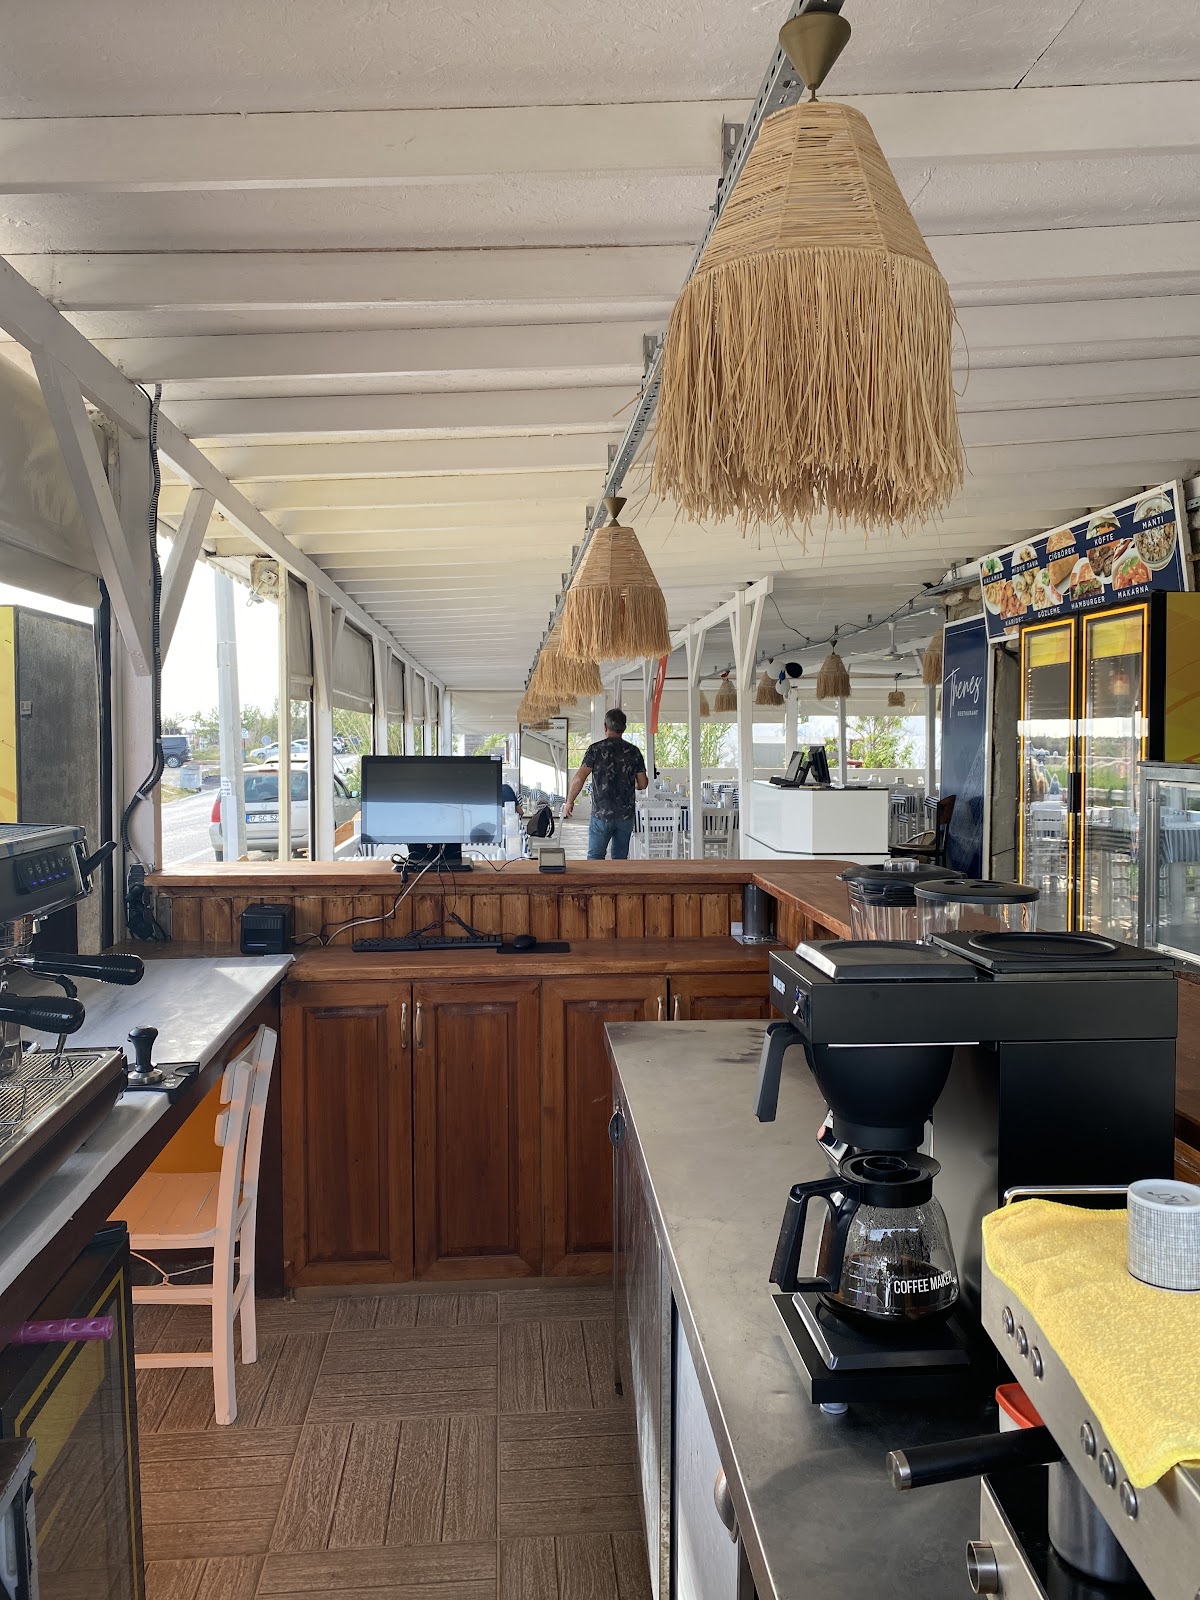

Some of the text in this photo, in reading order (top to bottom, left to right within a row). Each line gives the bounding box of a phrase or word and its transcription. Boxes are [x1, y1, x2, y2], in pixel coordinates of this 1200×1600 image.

[1142, 516, 1164, 529] MANTI
[1094, 533, 1114, 546] KÖFTE
[1048, 547, 1076, 562] ÇİĞBÖREK
[1117, 585, 1149, 599] MAKARNA
[1070, 596, 1106, 610] HAMBURGER
[1037, 606, 1061, 618] GÖZLEME
[893, 1278, 930, 1295] COFFEE
